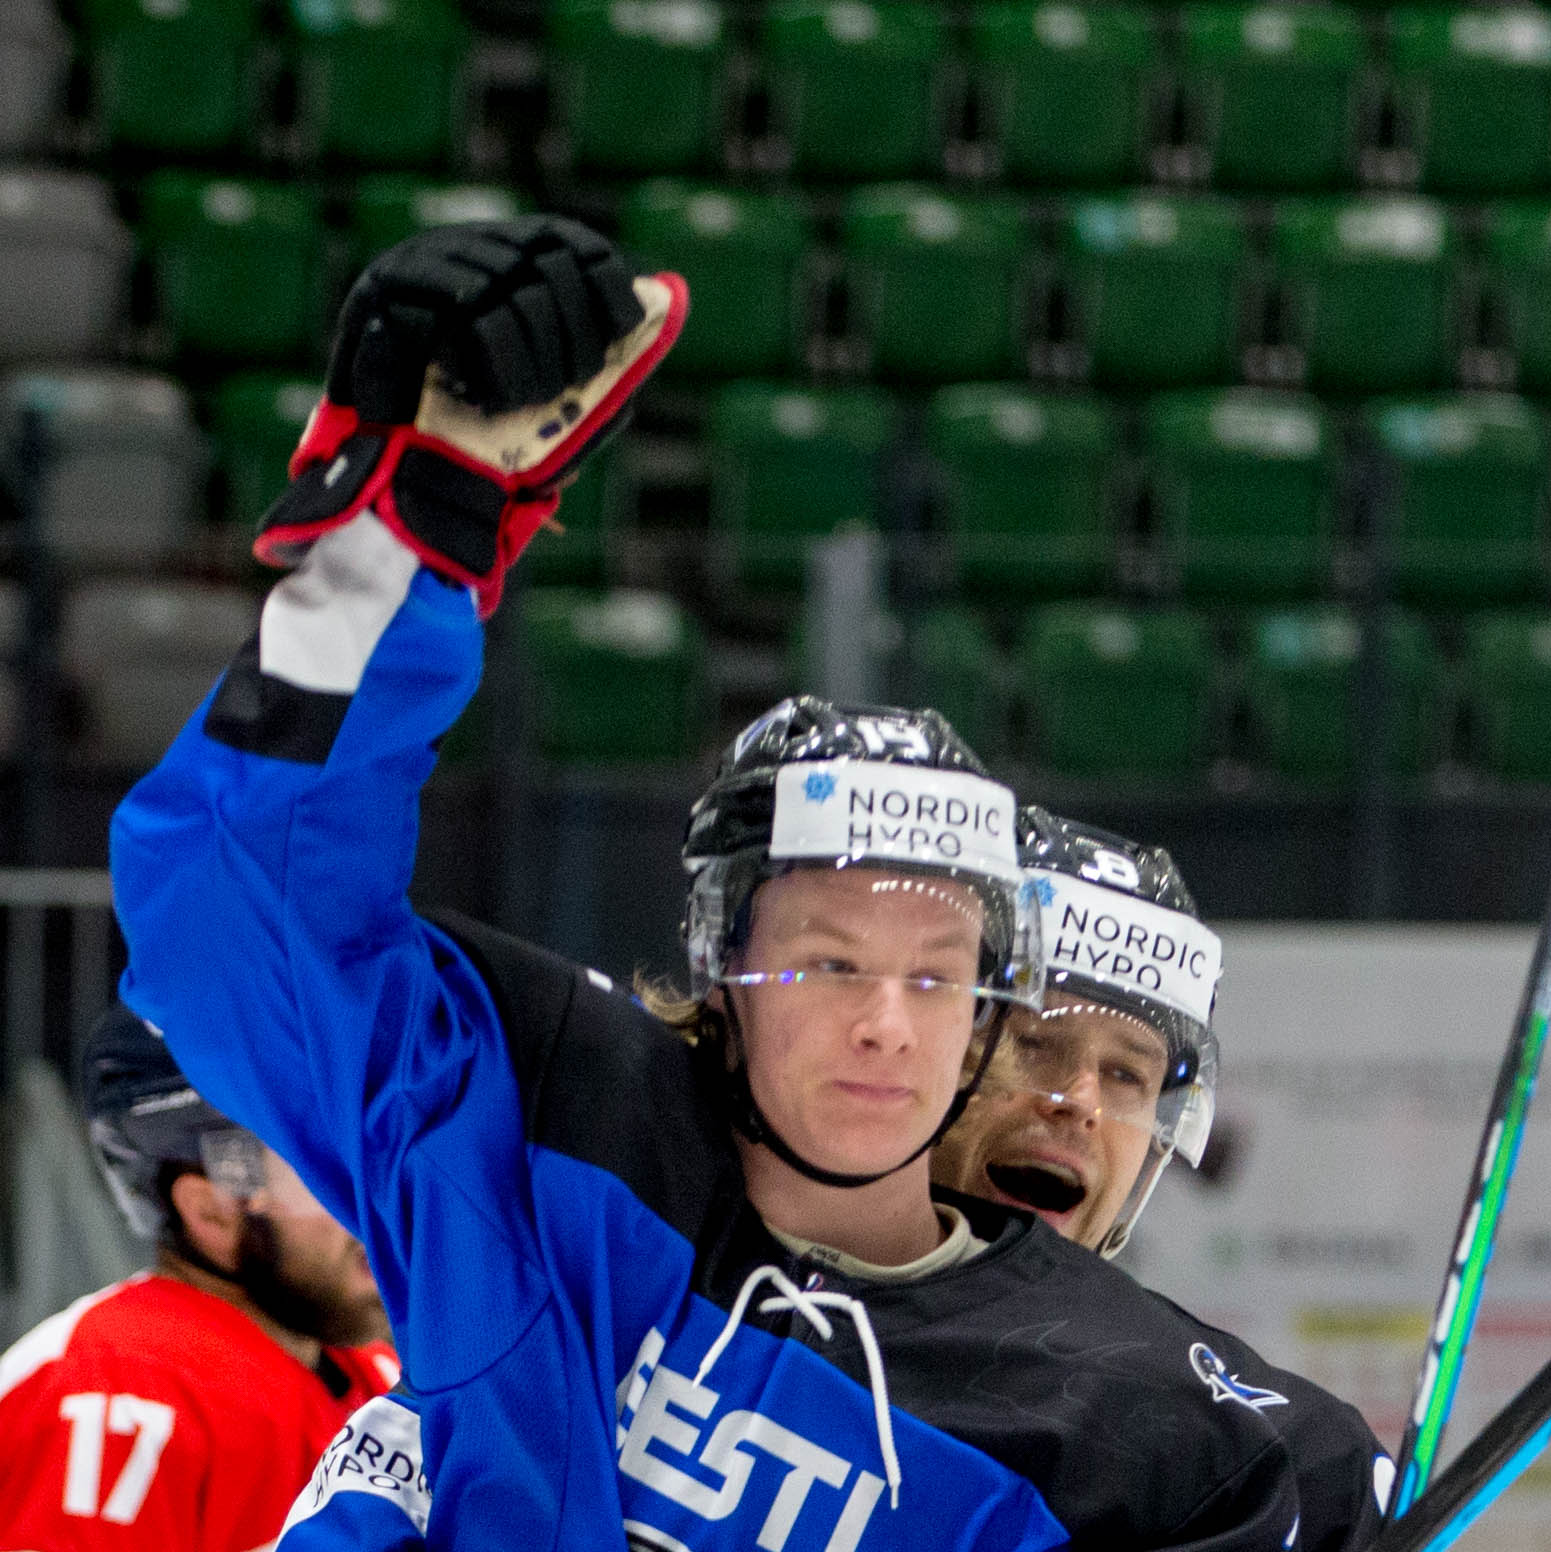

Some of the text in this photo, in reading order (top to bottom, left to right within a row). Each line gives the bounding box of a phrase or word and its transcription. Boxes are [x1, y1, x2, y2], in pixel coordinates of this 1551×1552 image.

[850, 788, 1000, 837] NORDIC
[849, 823, 963, 859] HYPO
[1054, 936, 1162, 991] HYPO
[1061, 903, 1207, 979] NORDIC
[59, 1392, 177, 1525] 17
